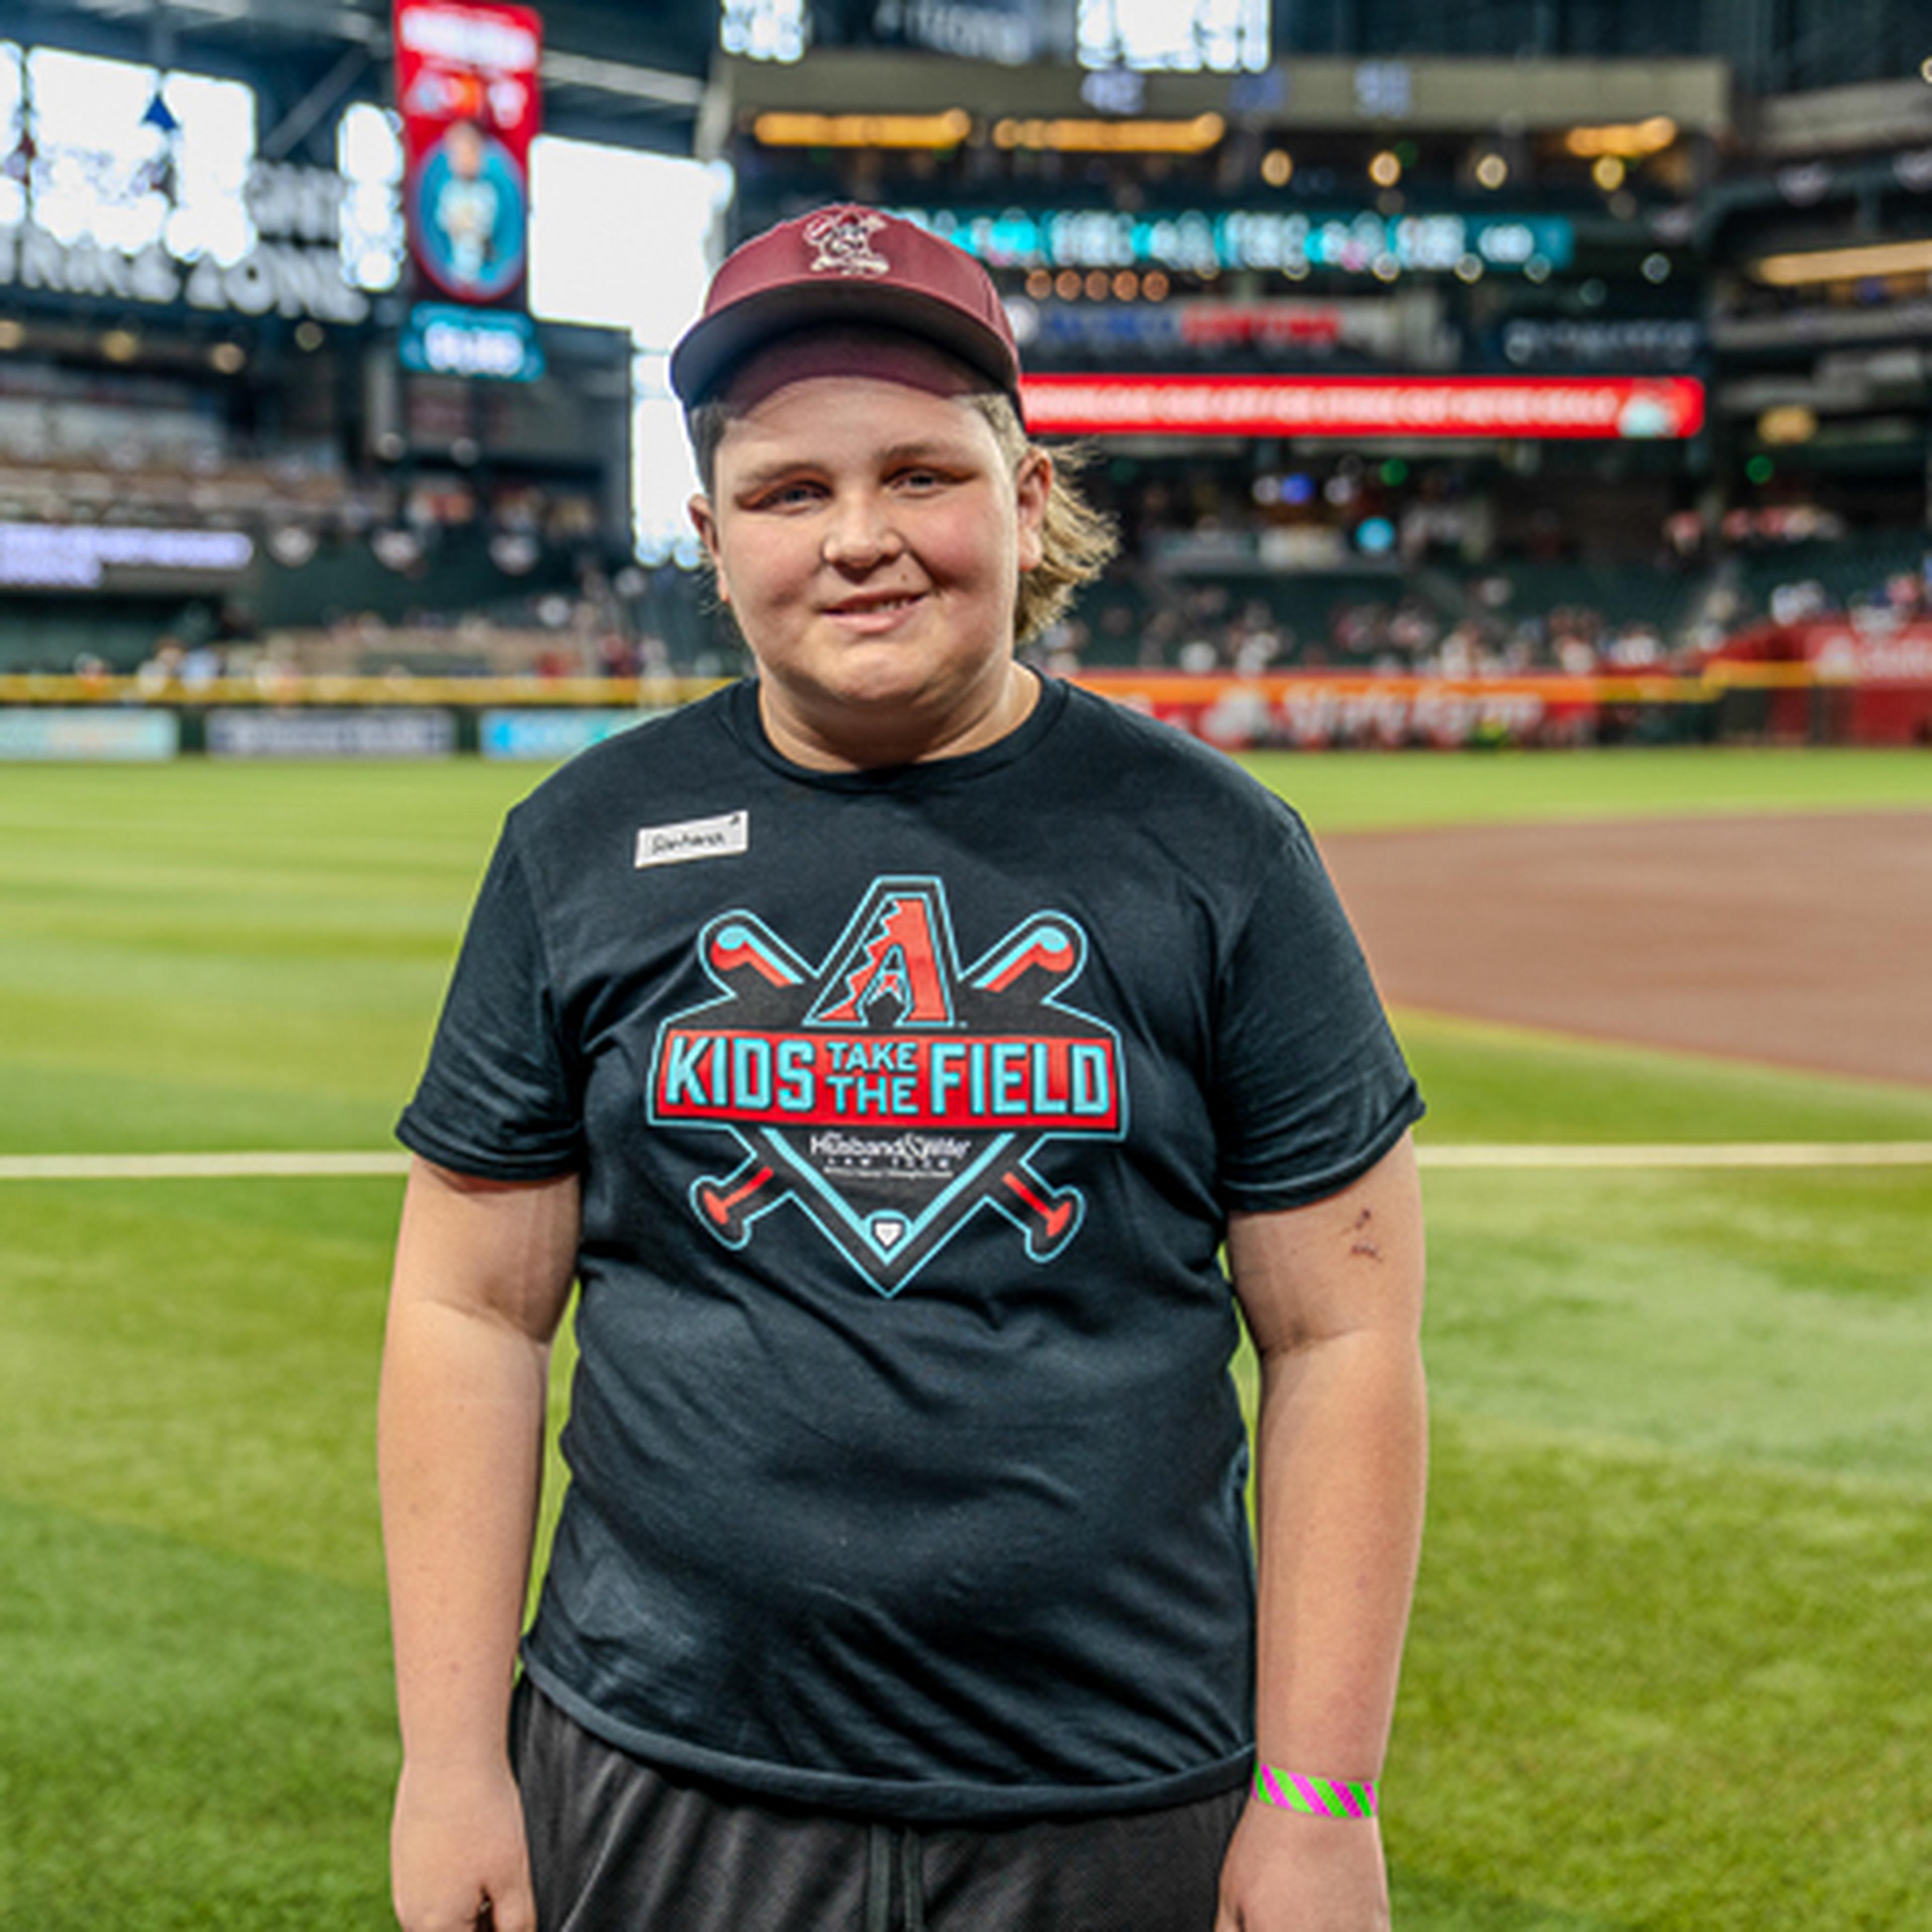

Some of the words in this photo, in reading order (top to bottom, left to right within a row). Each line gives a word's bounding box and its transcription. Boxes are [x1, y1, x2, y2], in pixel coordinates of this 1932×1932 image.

[665, 1035, 816, 1111] KIDS
[826, 1041, 918, 1072] TAKE
[931, 1042, 1110, 1115] FIELD
[825, 1075, 919, 1114] THE
